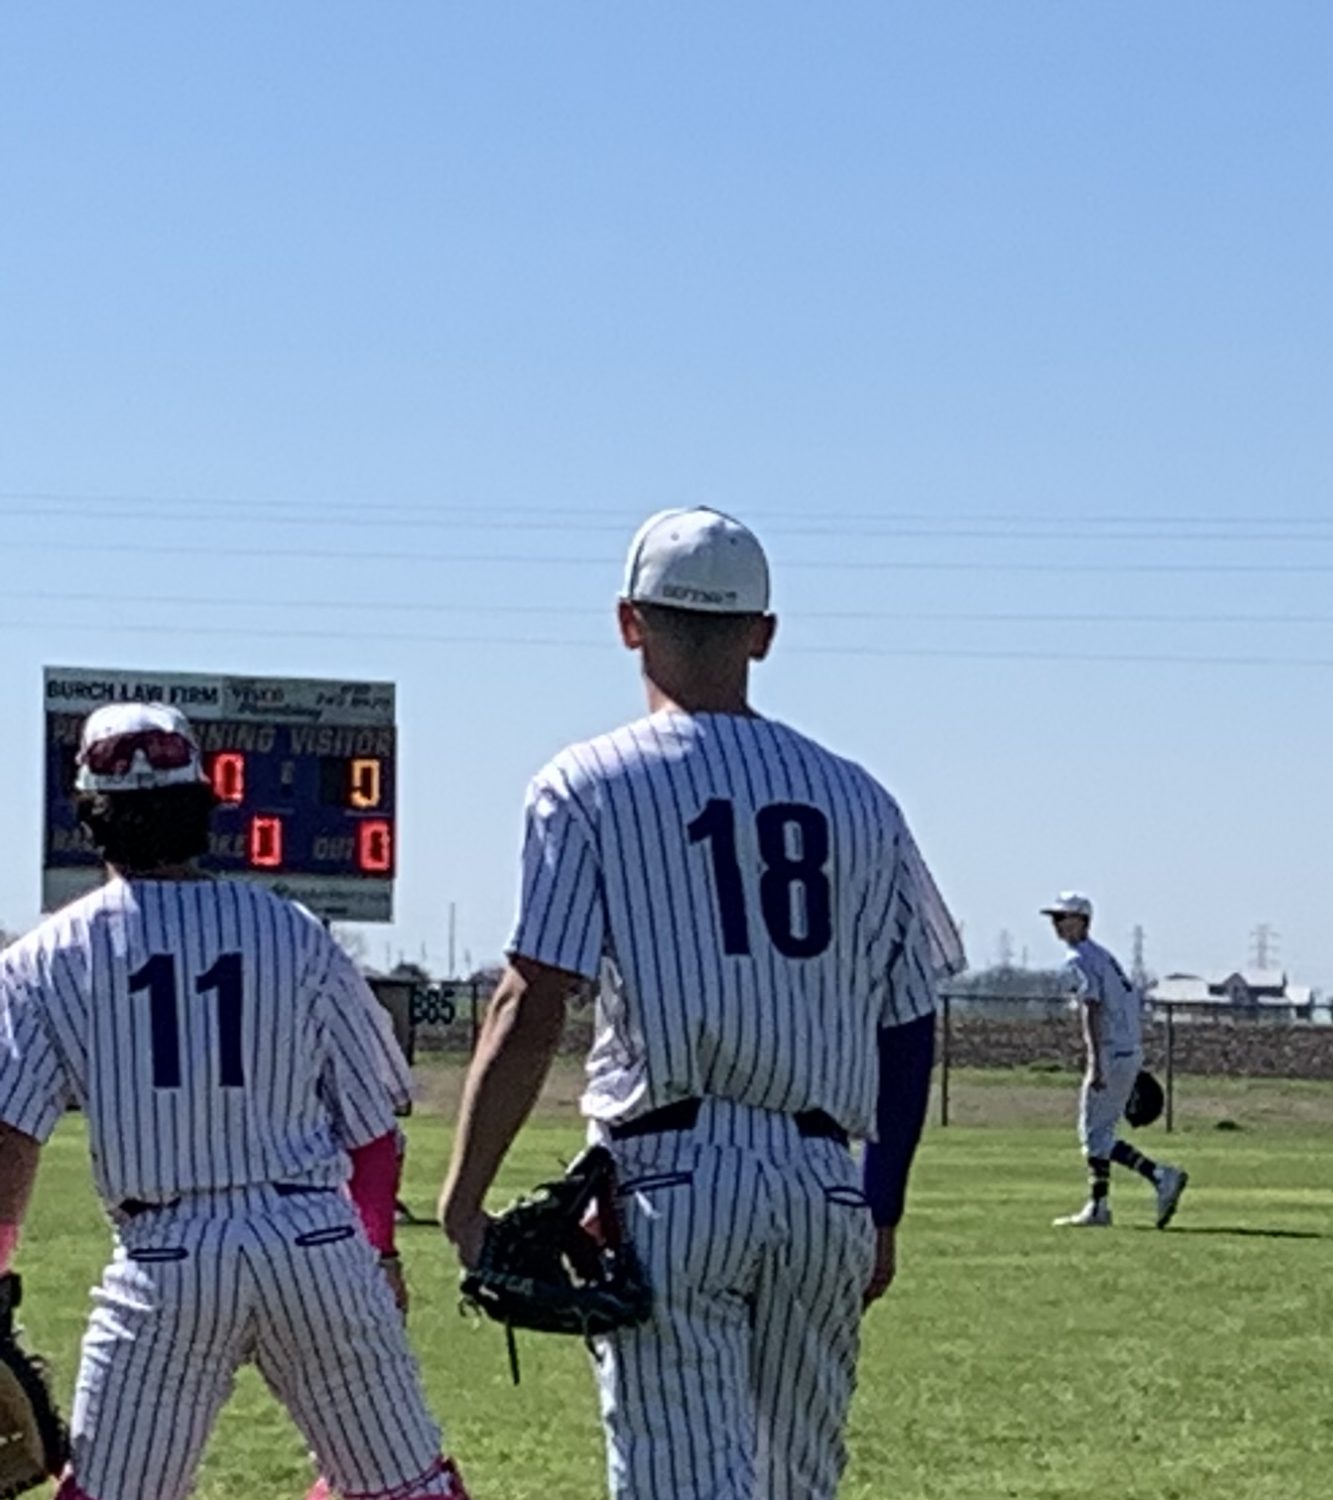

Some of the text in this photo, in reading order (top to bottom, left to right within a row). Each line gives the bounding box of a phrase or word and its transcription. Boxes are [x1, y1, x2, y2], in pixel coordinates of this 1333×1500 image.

[47, 679, 115, 700] BURCH
[119, 683, 163, 701] LAW
[170, 686, 218, 705] FIRM
[288, 726, 392, 757] VISITOR
[213, 752, 244, 803] 0
[250, 815, 282, 867] 0
[687, 798, 833, 960] 18
[128, 953, 244, 1088] 11
